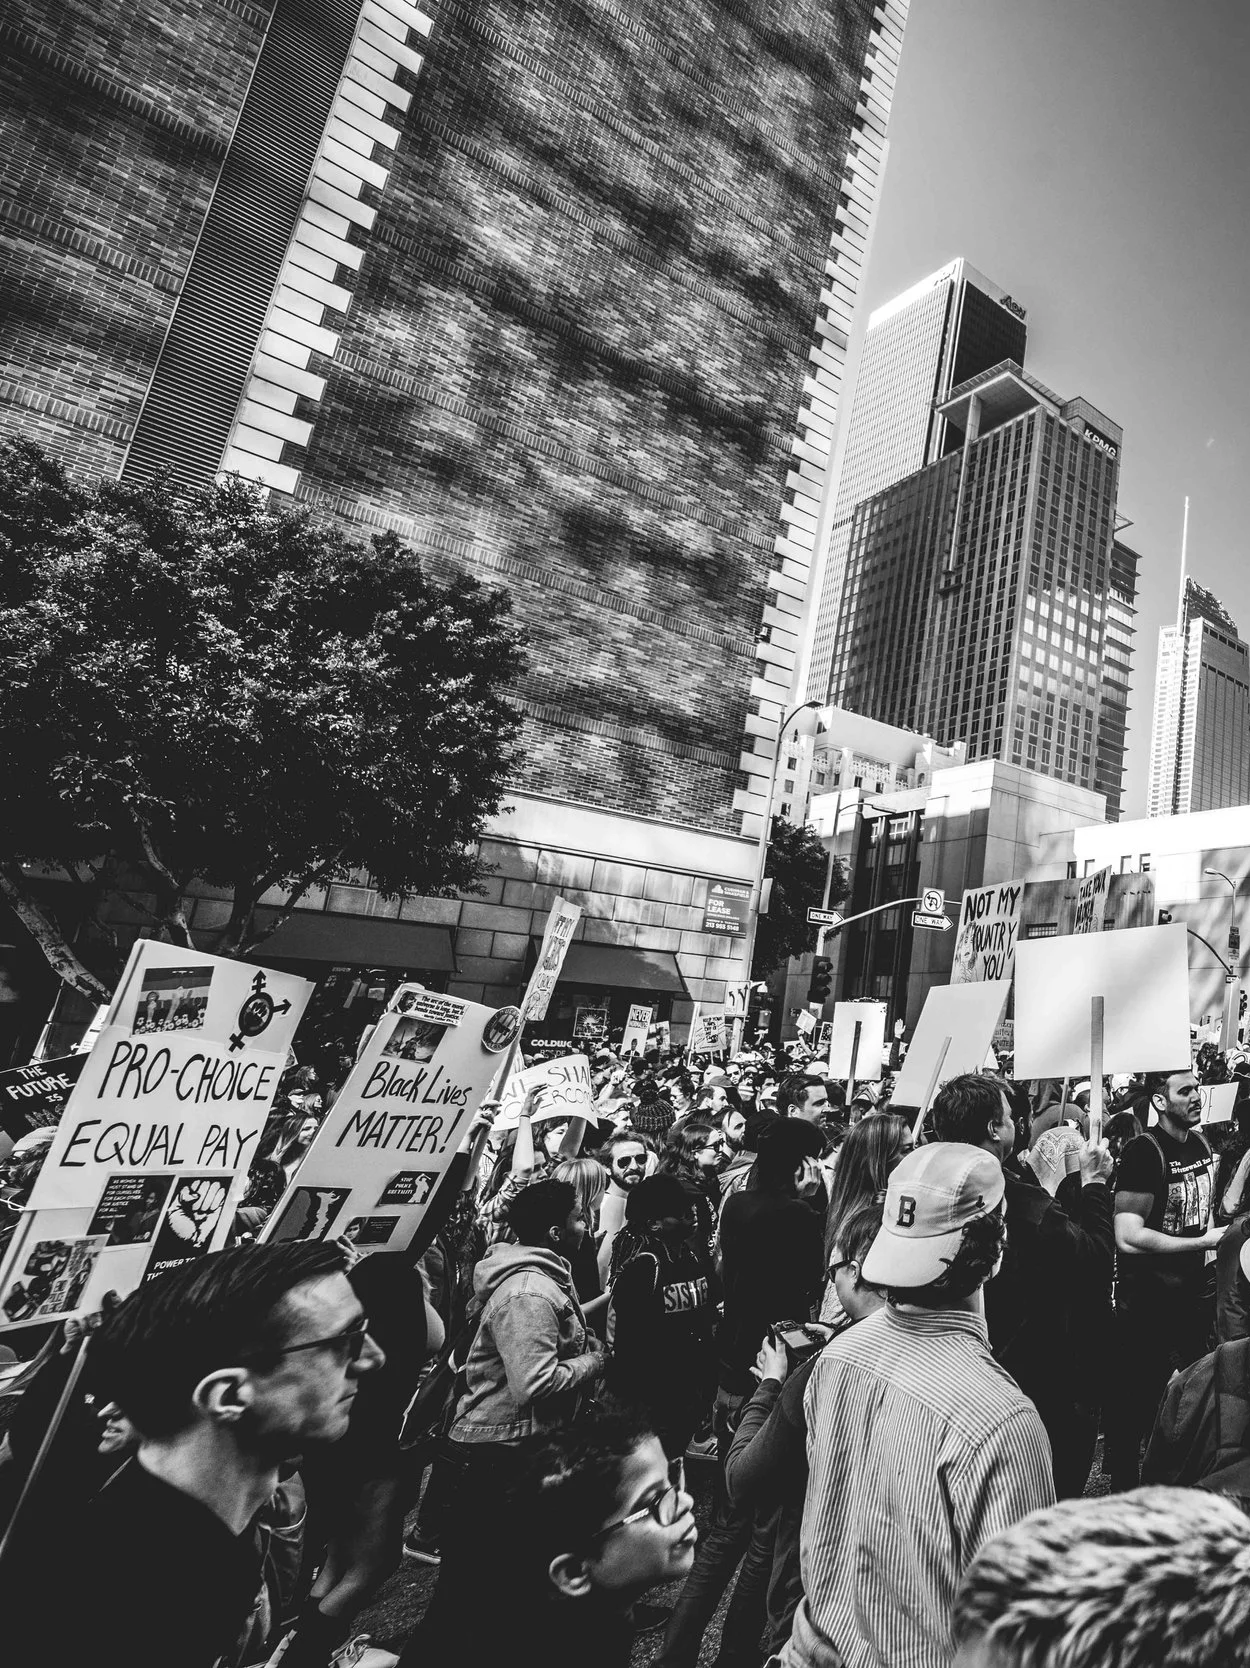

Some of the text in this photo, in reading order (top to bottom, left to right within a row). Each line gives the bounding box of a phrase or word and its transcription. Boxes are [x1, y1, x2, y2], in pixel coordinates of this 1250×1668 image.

[708, 899, 724, 908] FOR
[708, 906, 731, 915] LEASE
[964, 886, 1021, 925] NOT MY
[916, 916, 928, 924] ONE
[983, 954, 1006, 981] YOU
[631, 1008, 650, 1022] NEVER
[16, 1066, 48, 1080] THE
[97, 1041, 276, 1104] PRO-CHOICE
[6, 1072, 76, 1100] FUTURE
[361, 1061, 473, 1106] Black Lives
[45, 1093, 64, 1102] IS
[334, 1108, 466, 1154] MATTER!
[59, 1119, 258, 1170] EQUAL PAY
[1170, 1160, 1203, 1174] Stonewall
[896, 1195, 917, 1228] B
[154, 1258, 184, 1270] POWER
